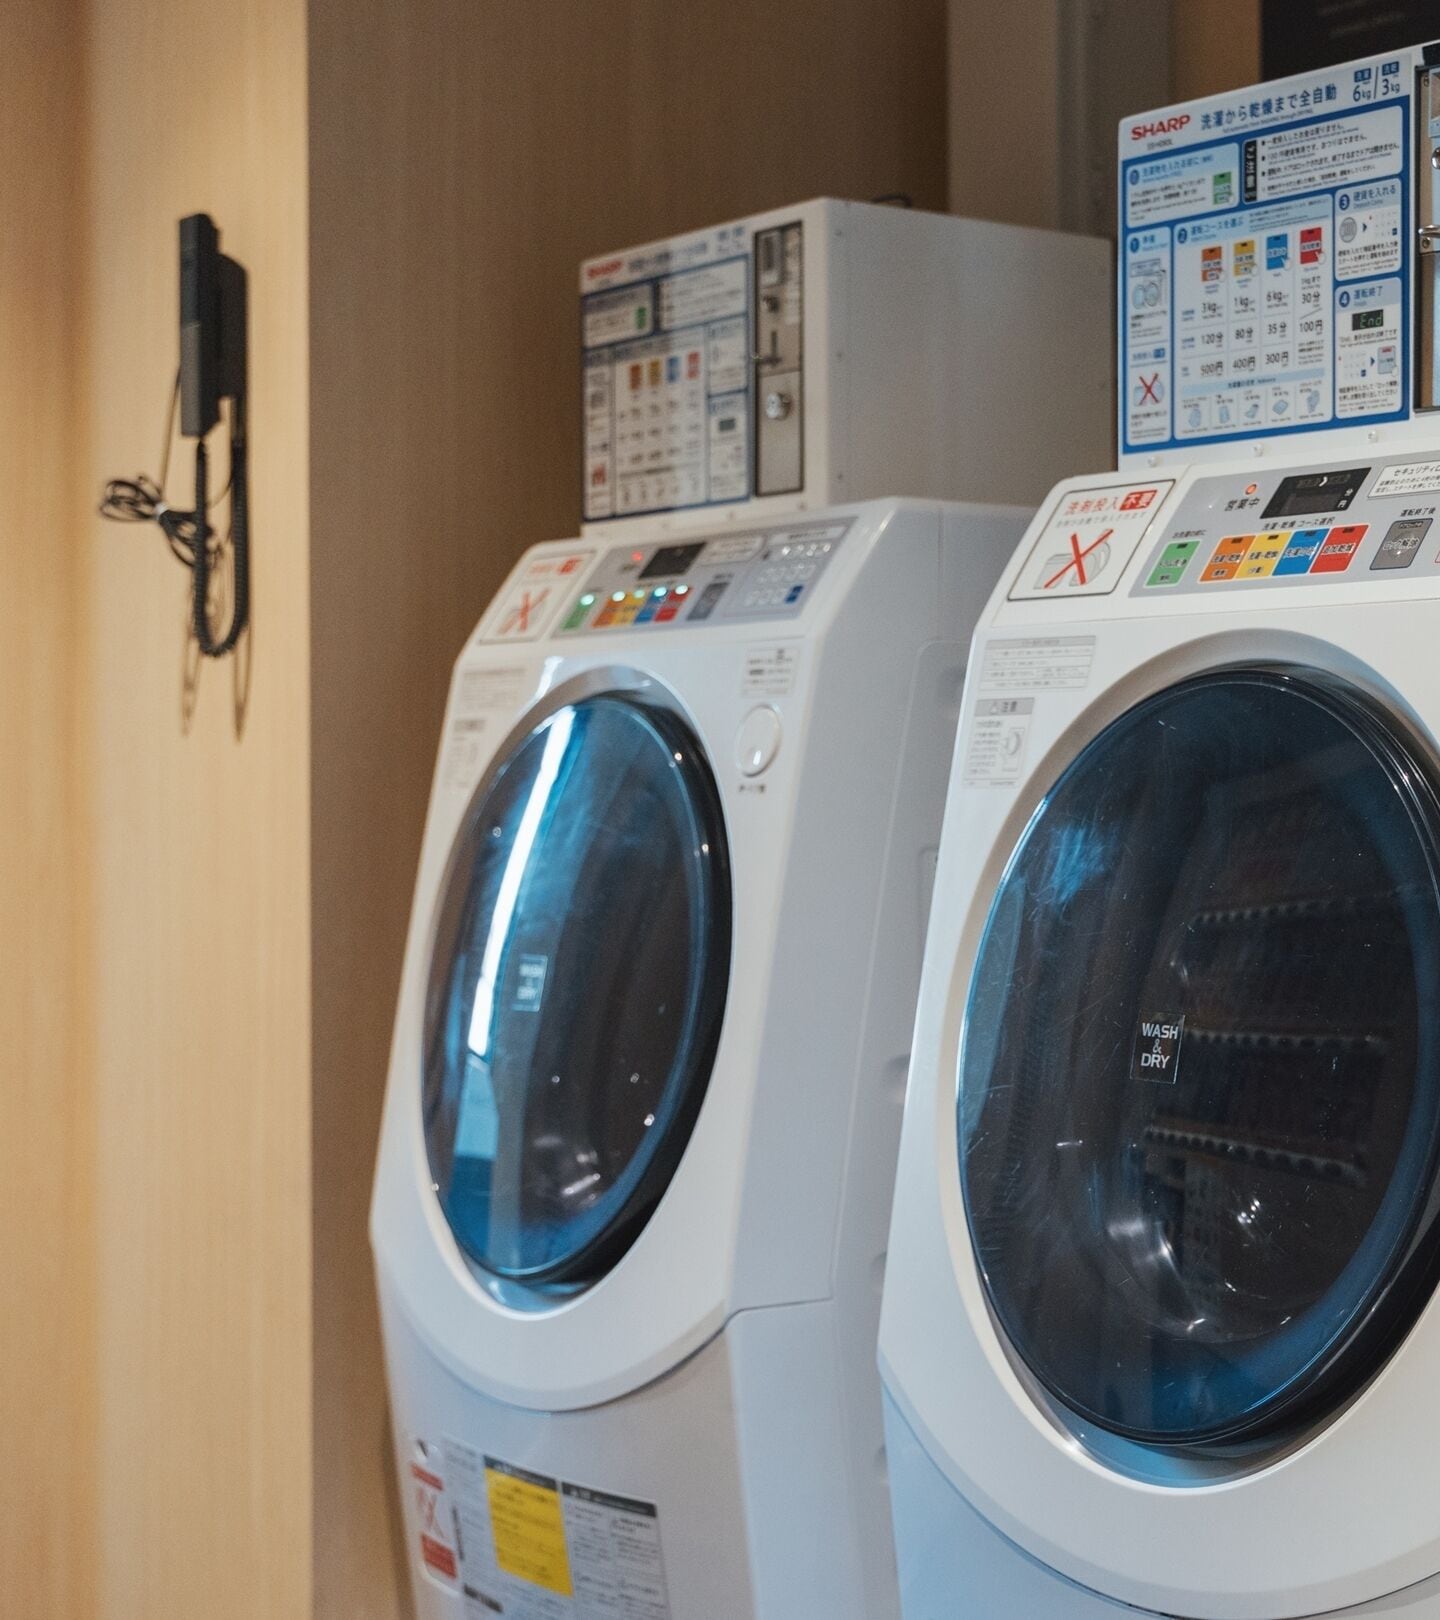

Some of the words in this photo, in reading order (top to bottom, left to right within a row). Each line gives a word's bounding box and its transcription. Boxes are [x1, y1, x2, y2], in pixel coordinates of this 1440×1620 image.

[1201, 84, 1338, 131] 洗濯から乾燥まで全自動
[1131, 115, 1191, 140] SHARP
[1353, 285, 1383, 298] 運転終了
[1300, 319, 1323, 333] 100円
[1360, 313, 1382, 329] End
[1201, 332, 1223, 345] 120分
[1235, 328, 1253, 340] 80分
[1268, 322, 1287, 335] 35分
[1201, 361, 1223, 376] 500円
[1232, 356, 1255, 370] 400円
[1265, 351, 1289, 365] 300円
[1064, 497, 1119, 516] 洗剤投入
[1120, 491, 1157, 510] 不要
[1225, 498, 1260, 512] 営業中
[1400, 507, 1436, 517] 運転終了後
[1142, 1022, 1179, 1040] WASH
[1152, 1039, 1162, 1053] &
[1141, 1053, 1170, 1069] DRY
